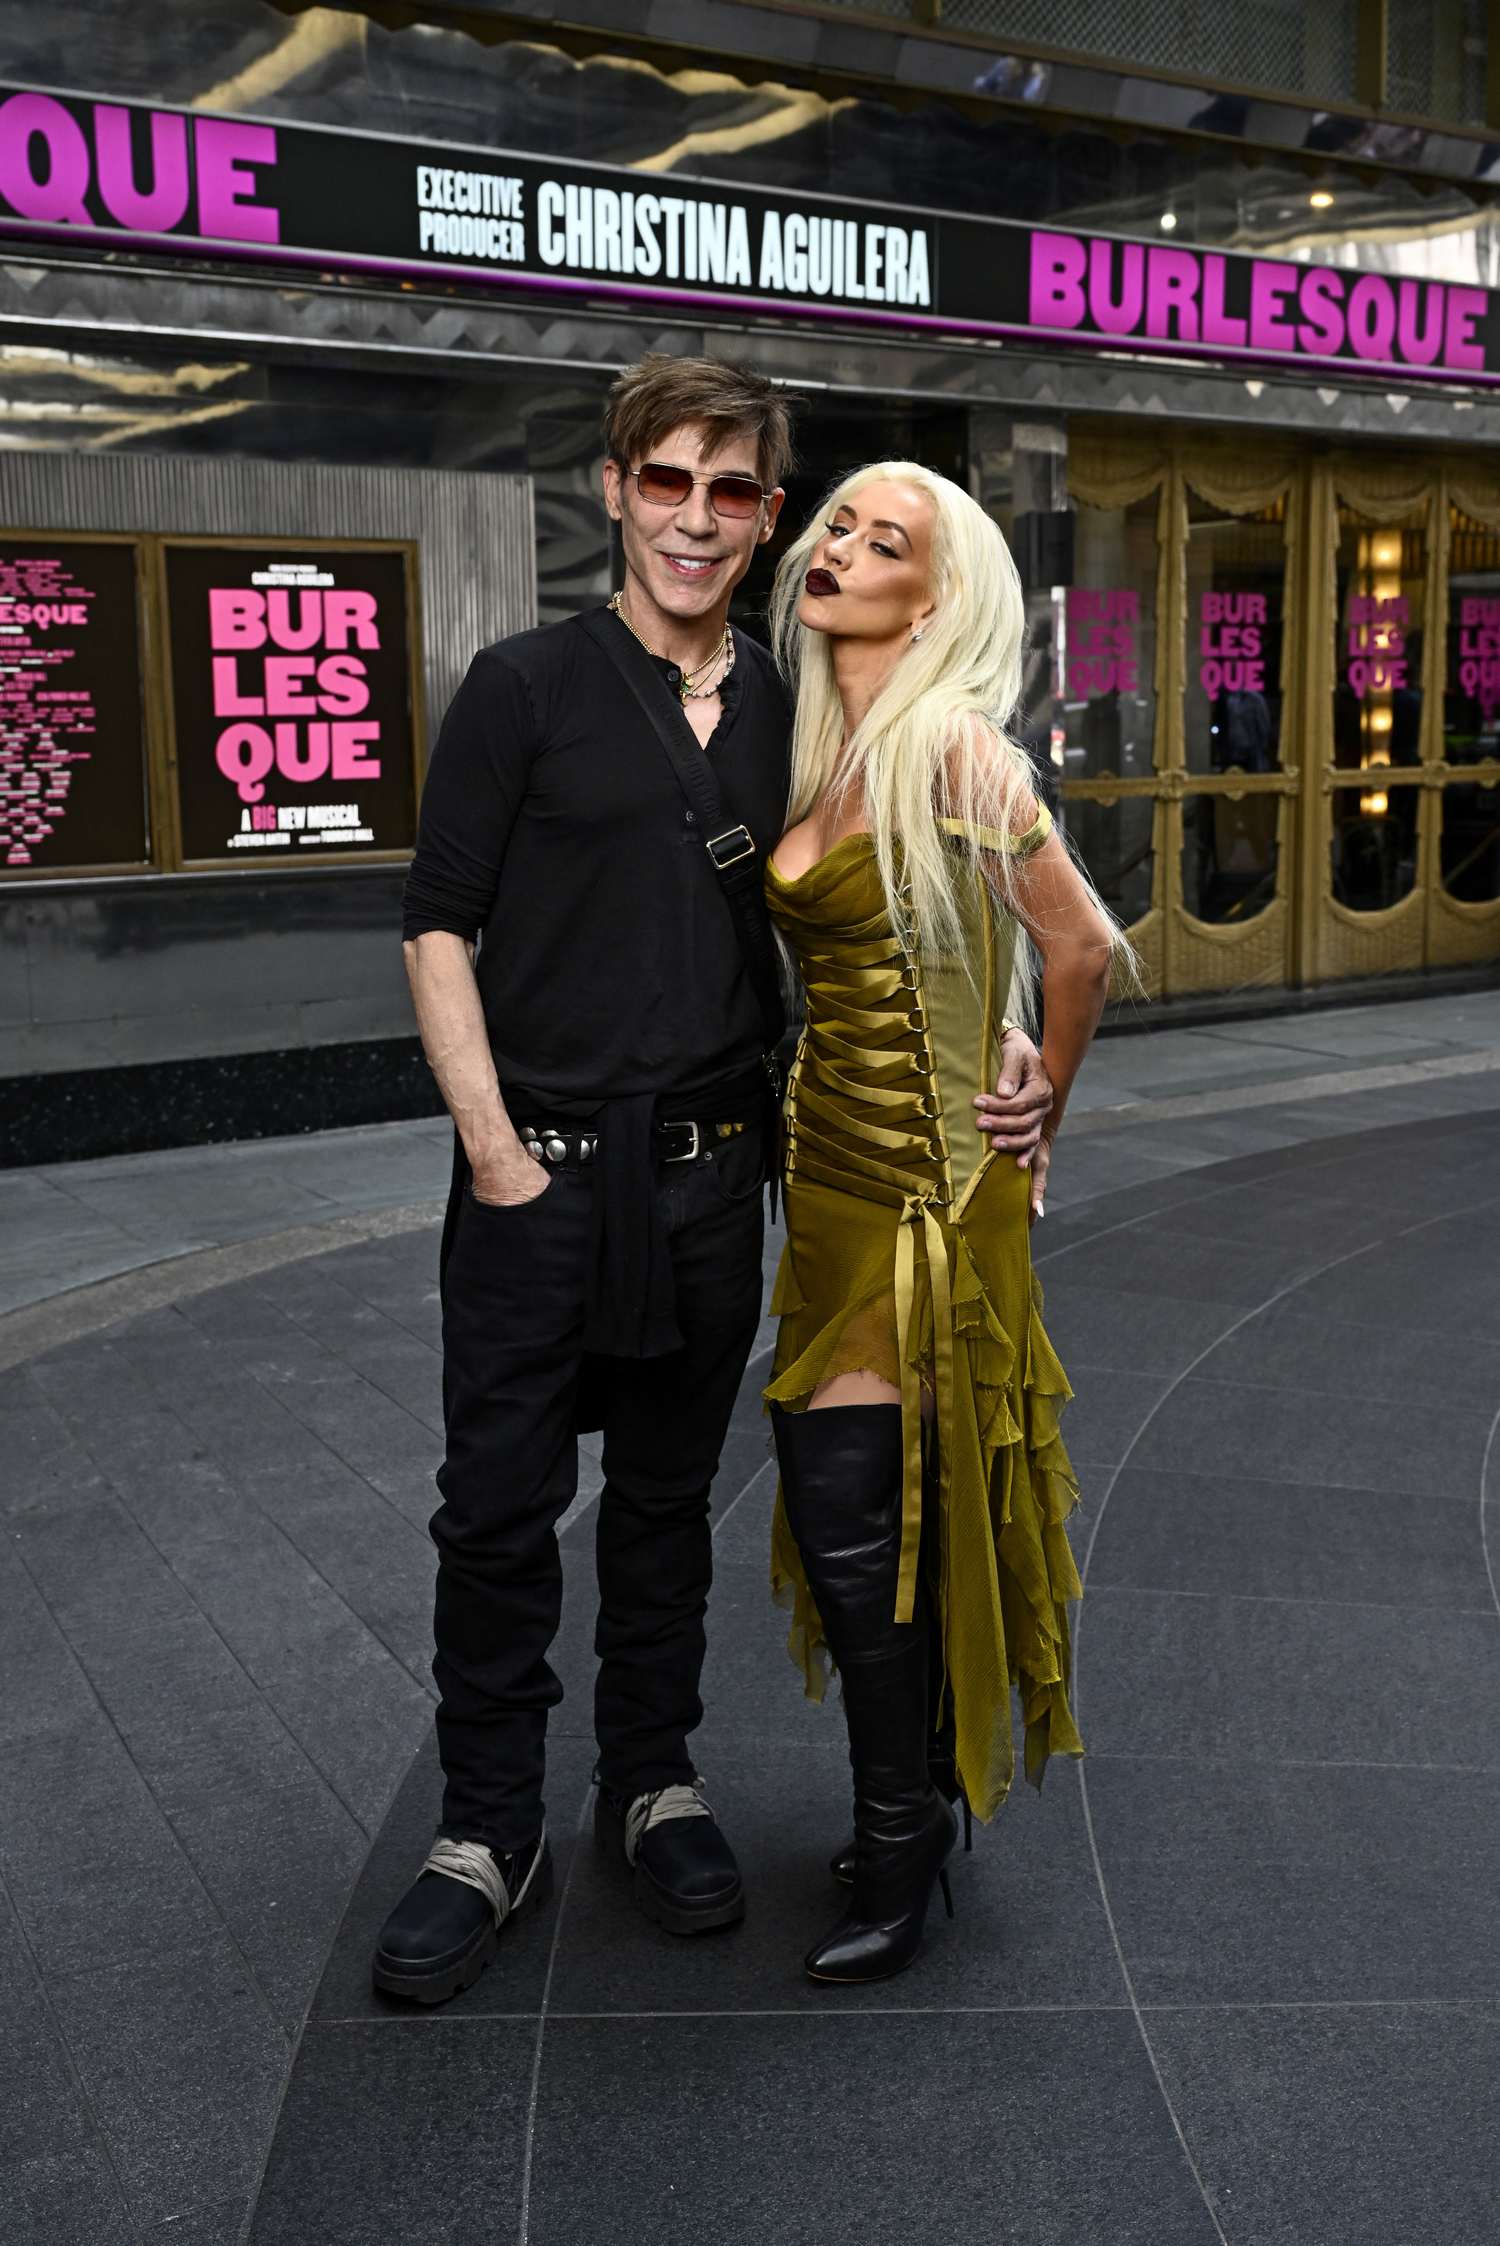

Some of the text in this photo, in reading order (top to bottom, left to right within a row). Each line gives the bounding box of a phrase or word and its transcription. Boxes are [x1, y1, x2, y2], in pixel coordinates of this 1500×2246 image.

[0, 92, 278, 244] QUE
[416, 165, 524, 219] EXECUTIVE
[419, 211, 526, 262] PRODUCER
[536, 180, 931, 306] CHRISTINA AGUILERA
[1029, 230, 1488, 371] BURLESQUE
[209, 588, 381, 651] BUR
[1201, 593, 1267, 625] BUR
[1201, 628, 1262, 659] LES
[212, 655, 370, 717] LES
[1200, 660, 1265, 701] QUE
[1348, 659, 1408, 699] QUE
[215, 721, 381, 803] QUE
